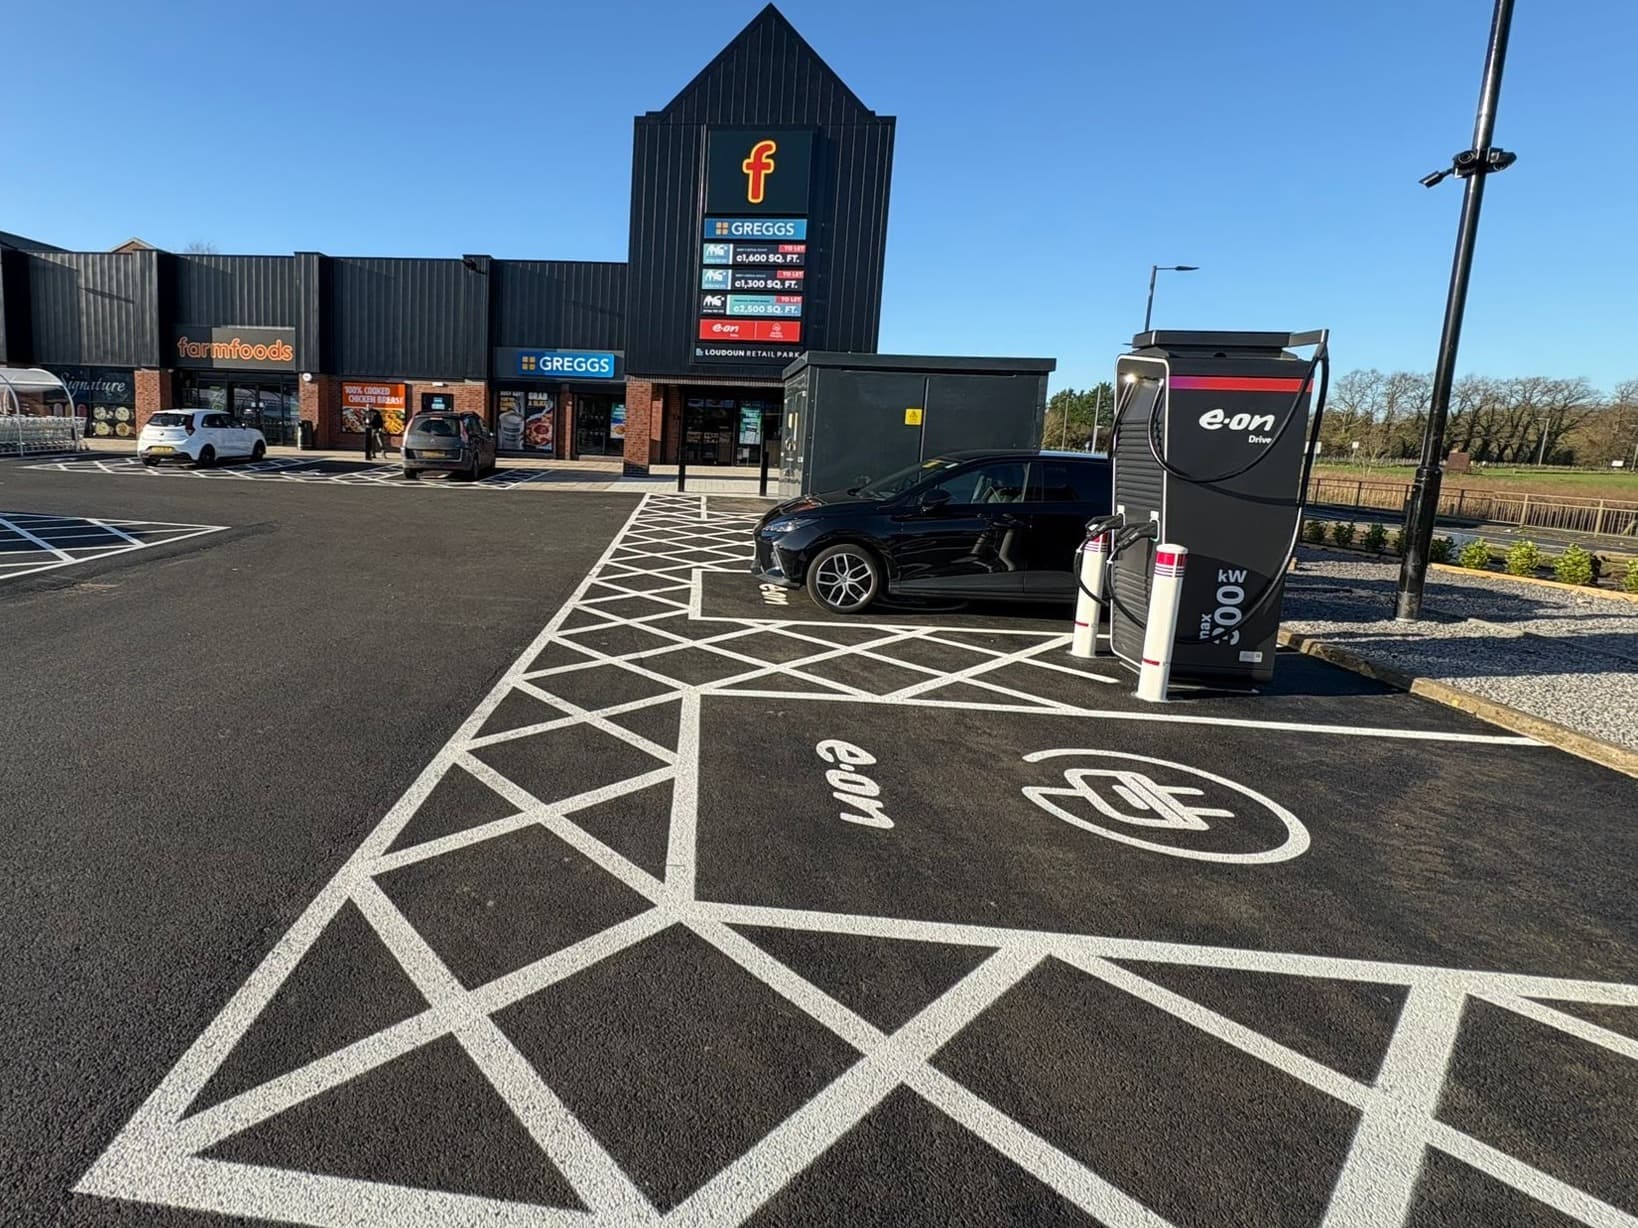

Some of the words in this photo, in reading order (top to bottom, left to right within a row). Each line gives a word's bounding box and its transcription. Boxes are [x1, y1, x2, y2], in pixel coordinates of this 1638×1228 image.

[742, 139, 776, 204] f
[731, 222, 795, 236] GREGGS
[736, 254, 767, 263] c1,600
[768, 254, 785, 263] SQ.
[787, 255, 800, 263] FT.
[735, 280, 765, 289] c1,300
[766, 280, 783, 289] SQ.
[784, 281, 798, 289] FT.
[733, 305, 765, 314] c2,500
[766, 305, 783, 314] SQ.
[784, 306, 798, 314] FT.
[177, 336, 294, 362] farmfoods
[704, 349, 745, 357] LOUDOUN
[746, 350, 775, 358] RETAIL
[777, 350, 800, 358] PARK
[539, 356, 610, 373] GREGGS
[61, 372, 126, 398] Signature
[345, 386, 363, 394] 100%
[348, 395, 376, 403] CHICKEN
[1248, 434, 1272, 444] Drive
[1217, 568, 1248, 583] kW
